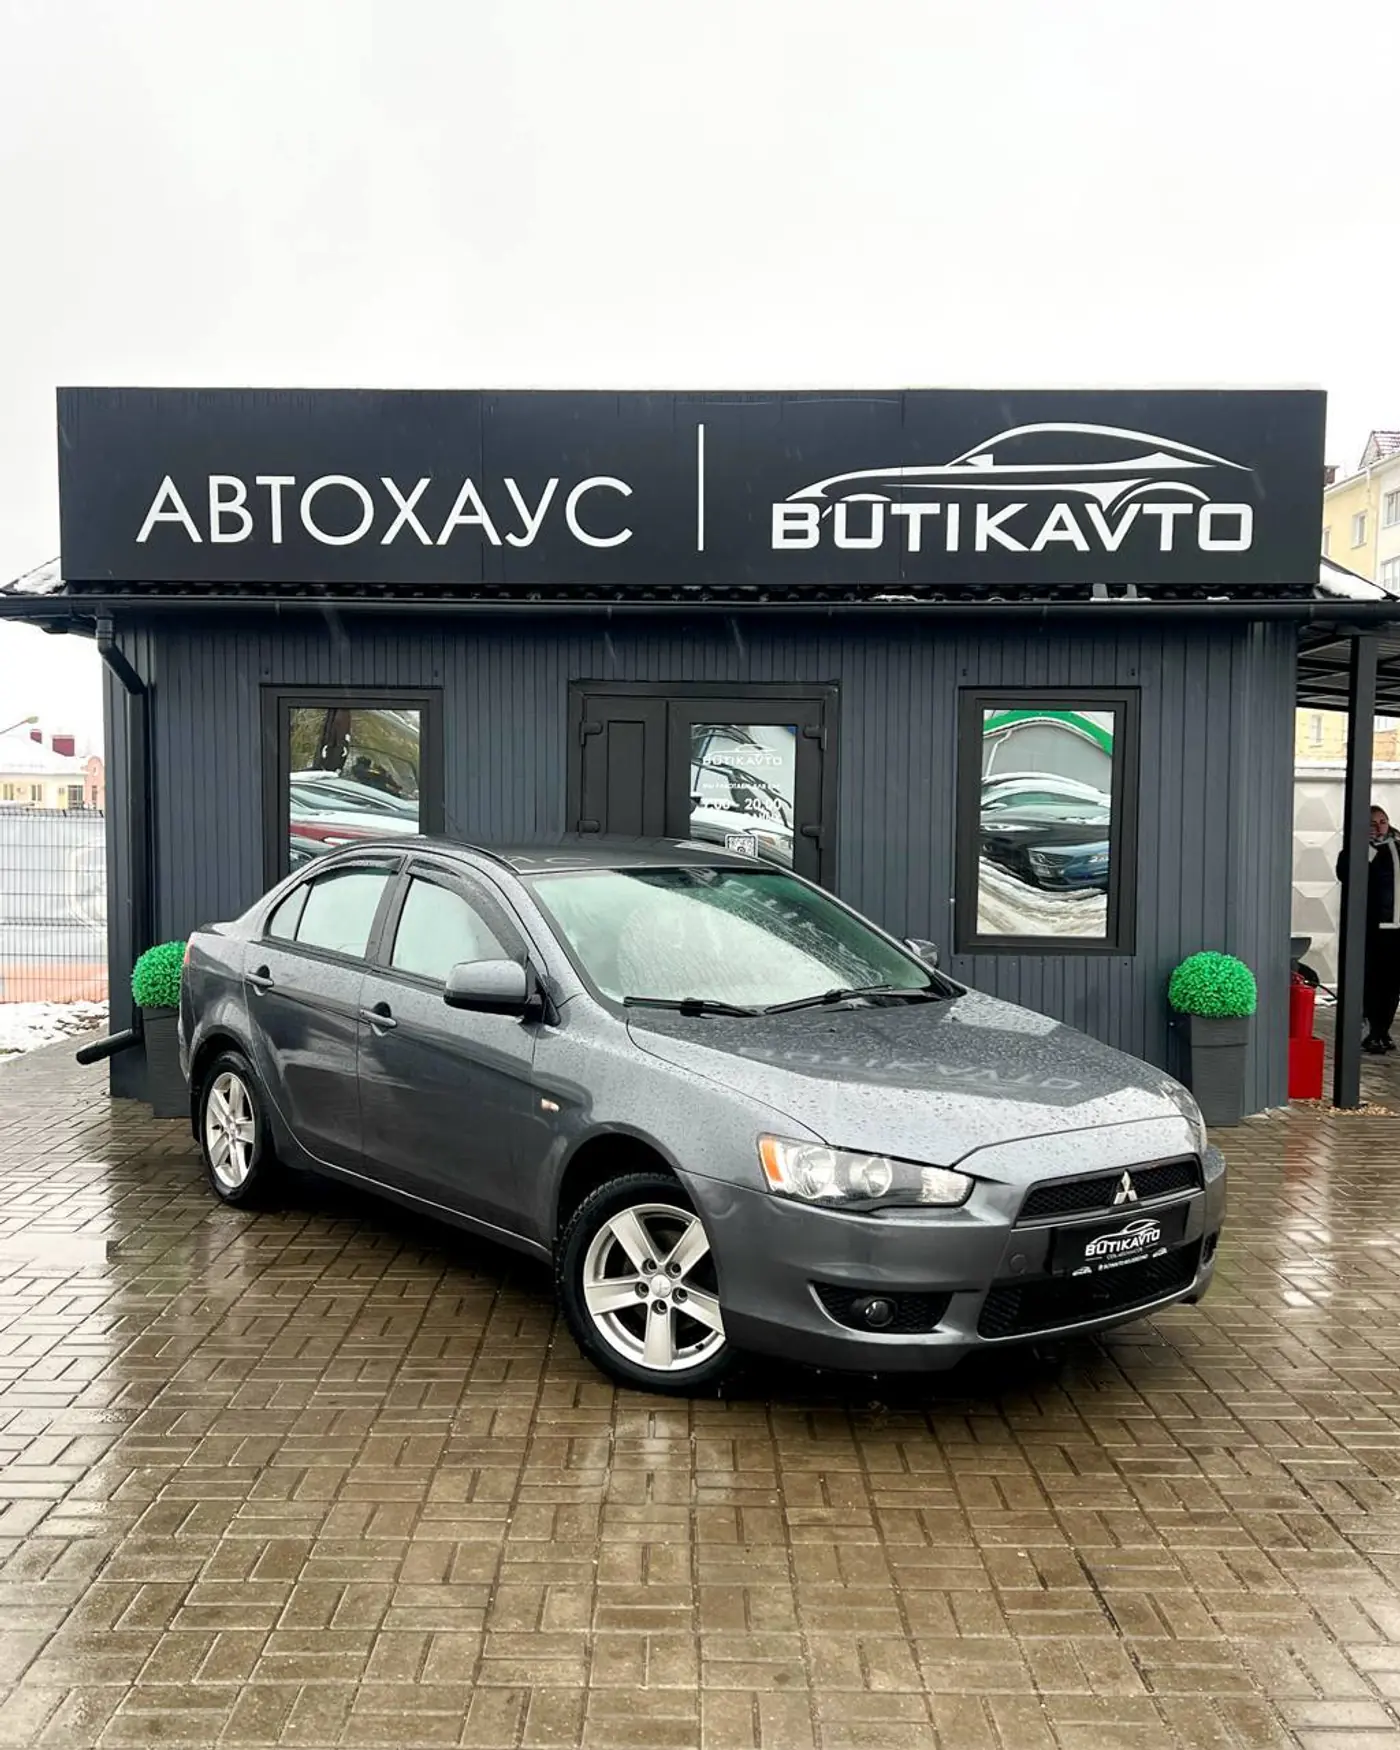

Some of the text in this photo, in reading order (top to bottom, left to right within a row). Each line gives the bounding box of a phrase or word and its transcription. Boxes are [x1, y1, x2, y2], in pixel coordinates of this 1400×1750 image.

[135, 474, 633, 548] АВТОХАУС
[771, 502, 1253, 552] BUTIKAVTO
[1085, 1228, 1160, 1257] BUTIKAVTO
